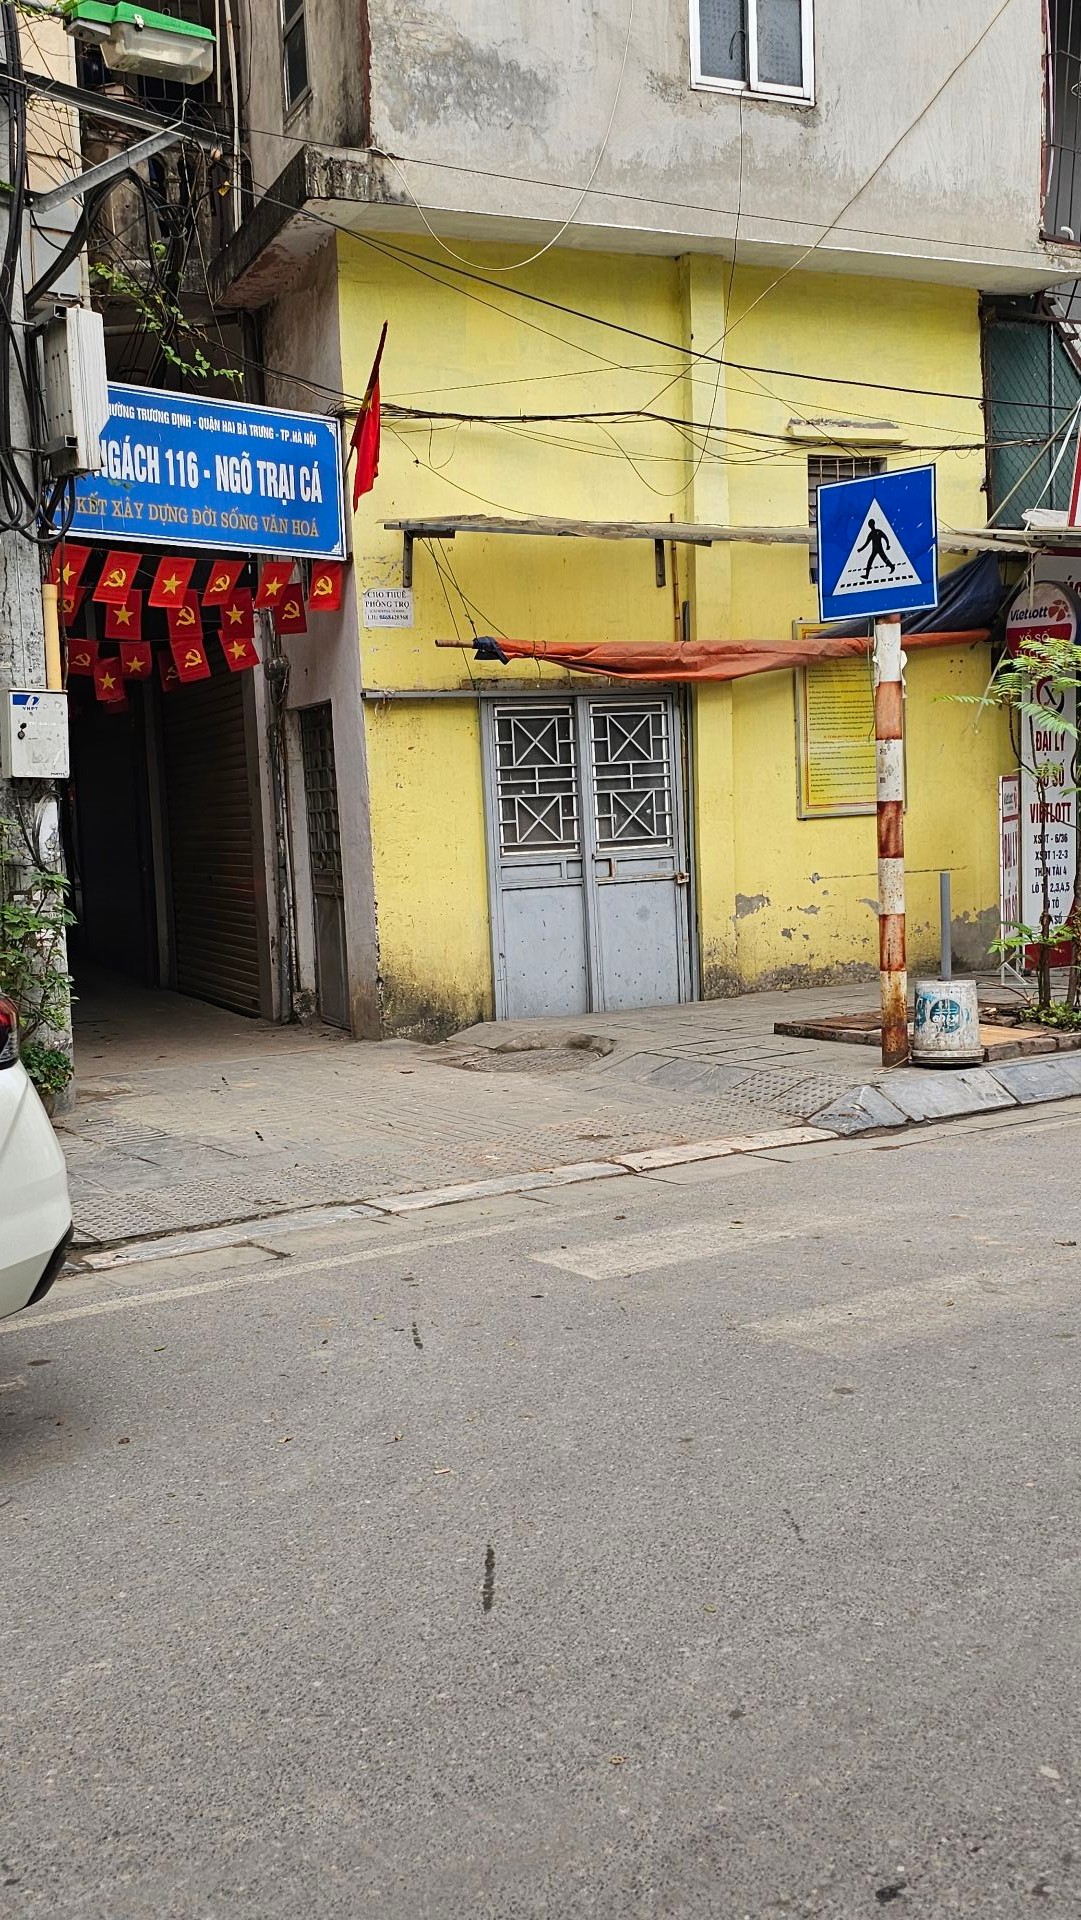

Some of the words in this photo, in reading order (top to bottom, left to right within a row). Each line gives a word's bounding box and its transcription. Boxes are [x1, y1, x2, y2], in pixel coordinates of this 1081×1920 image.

[136, 408, 170, 424] TRƯƠNG
[172, 412, 192, 428] ĐỊNH
[198, 416, 220, 432] QUẬN
[222, 421, 236, 434] HAI
[238, 420, 248, 436] BÀ
[249, 424, 274, 440] TRƯNG
[304, 430, 316, 448] NỘI
[94, 435, 160, 484] NGÁCH
[165, 448, 199, 488] 116
[215, 450, 252, 495] NGÕ
[256, 460, 296, 506] TRẠI
[300, 460, 322, 504] CÁ
[76, 491, 108, 516] KẾT
[112, 496, 144, 520] XÂY
[148, 503, 188, 526] DỰNG
[192, 505, 217, 526] ĐỜI
[220, 507, 258, 531] SỐNG
[262, 514, 288, 534] VĂN
[291, 518, 320, 537] HOÁ
[365, 600, 392, 608] PHÒNG
[394, 601, 410, 609] TRỌ
[386, 590, 406, 598] THUÊ
[1010, 606, 1048, 622] Vietlott
[1036, 730, 1052, 756] ĐẠI
[1053, 849, 1068, 860] 1-2-3
